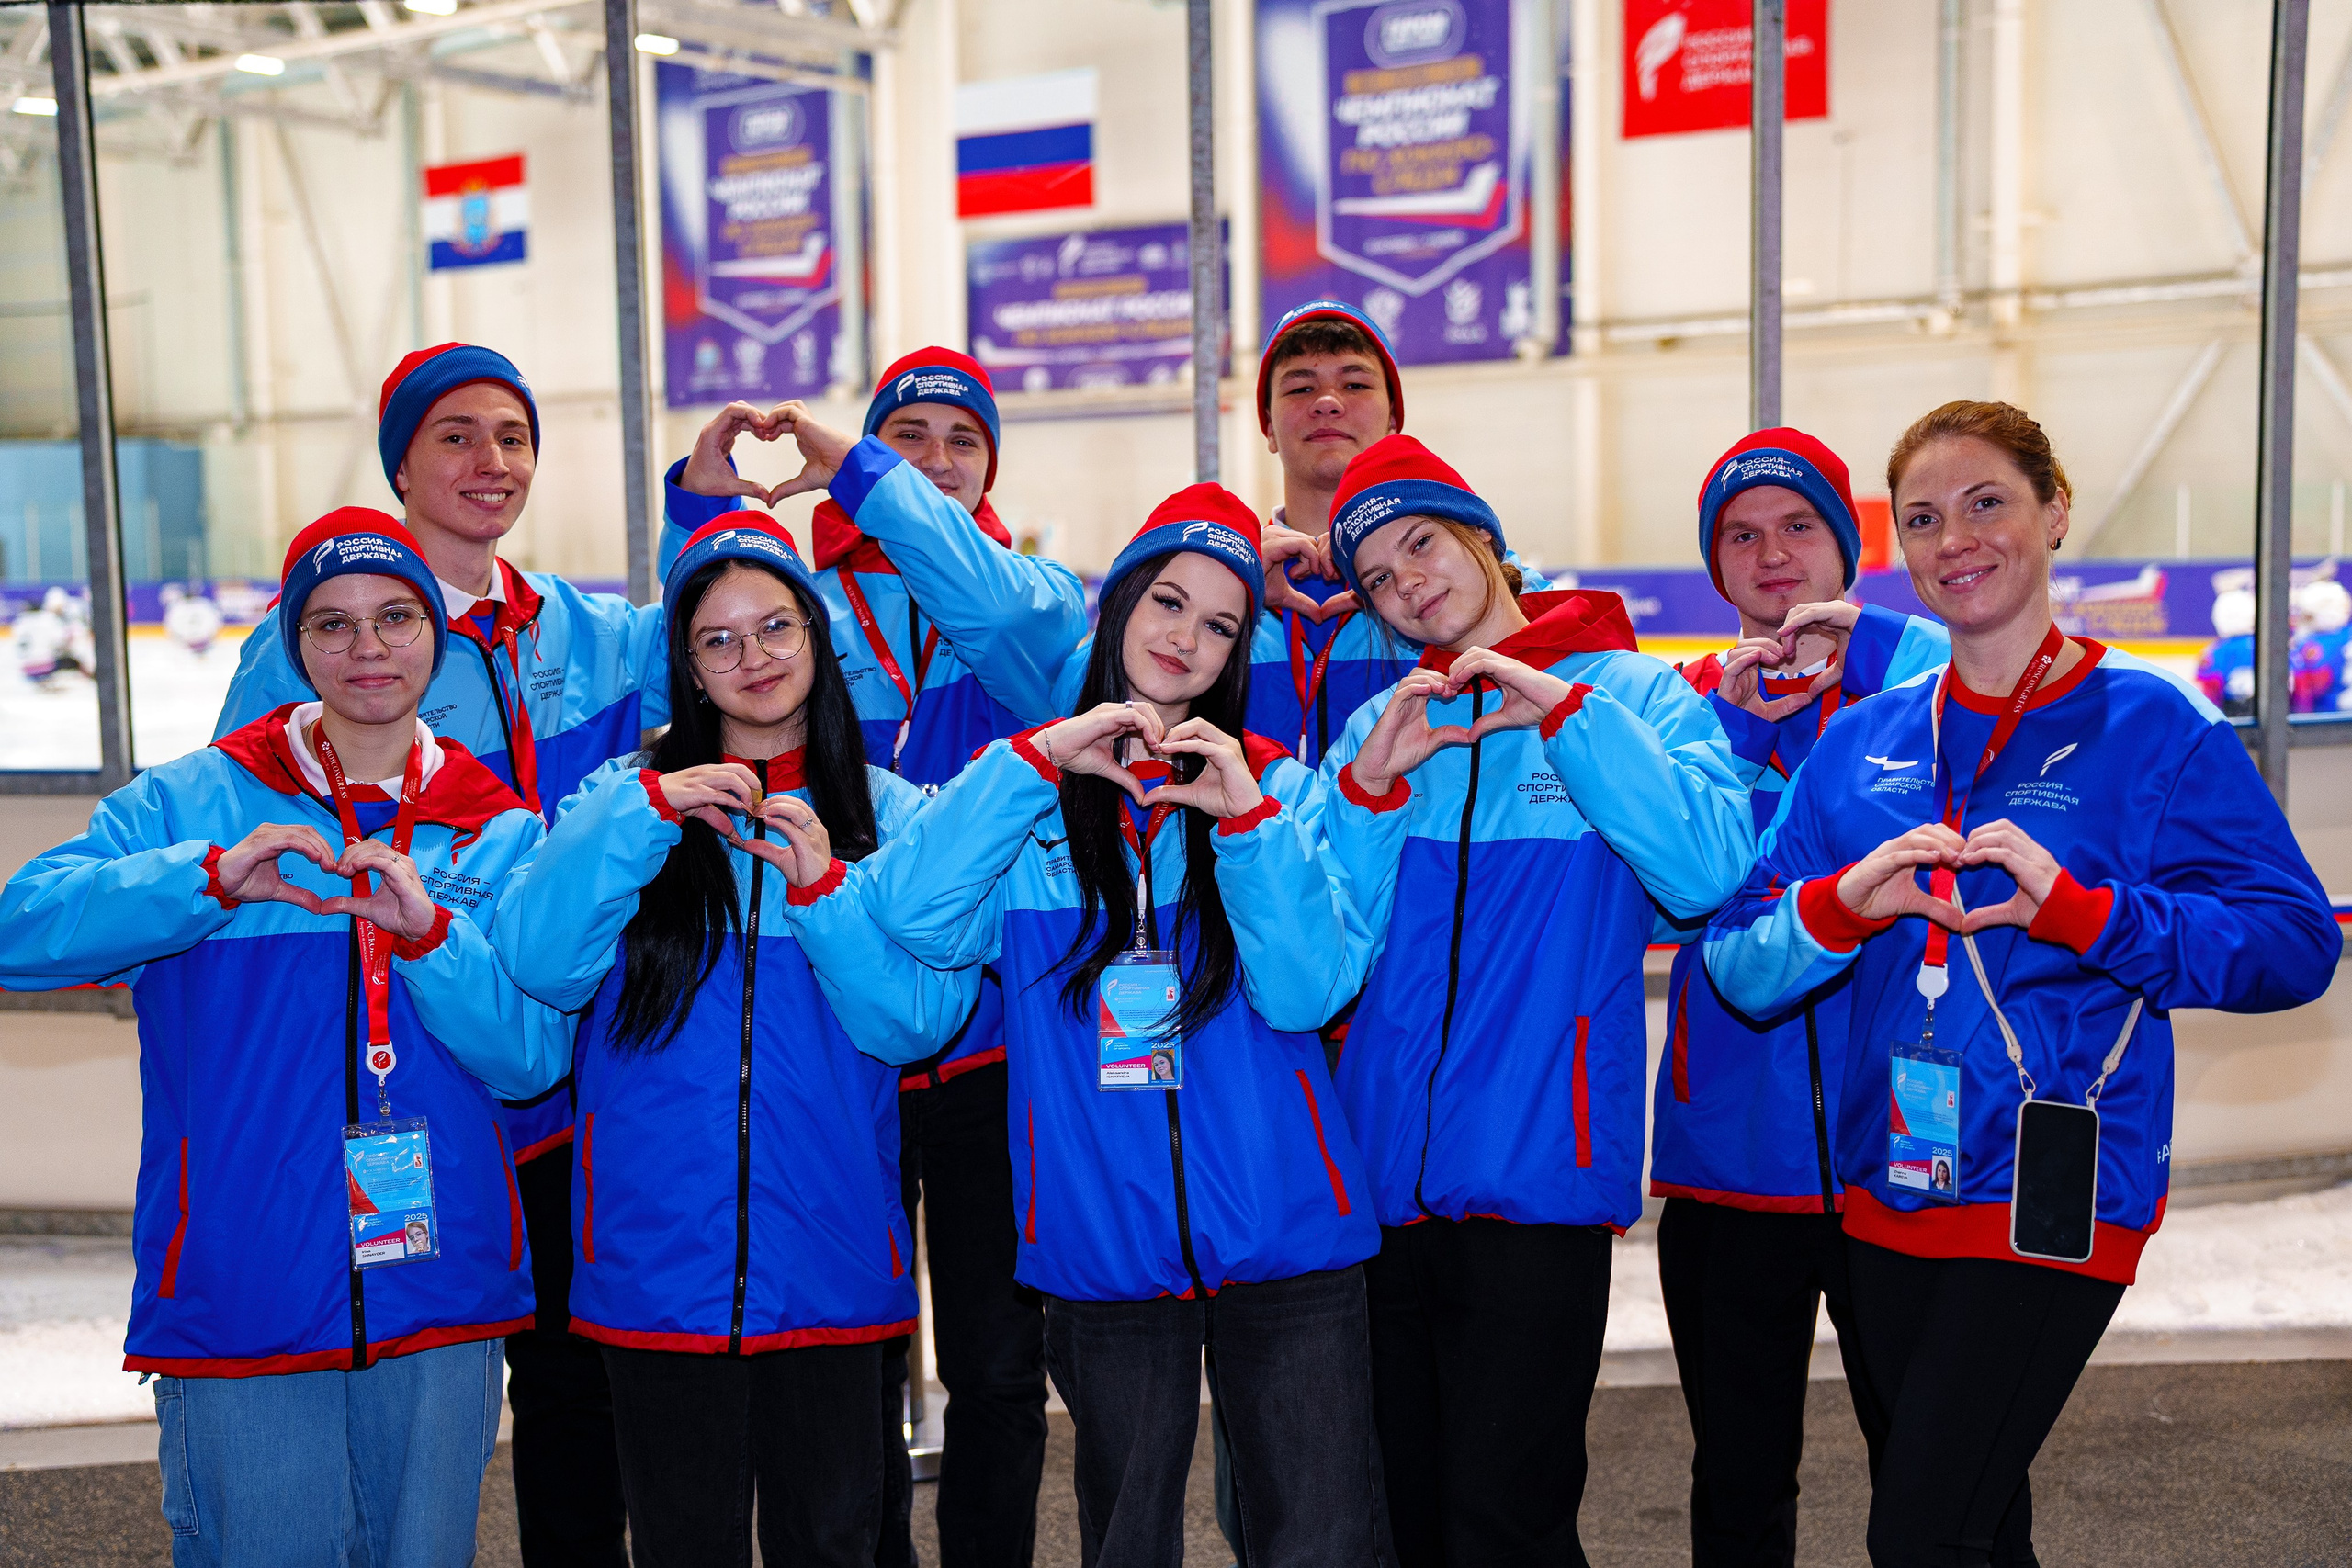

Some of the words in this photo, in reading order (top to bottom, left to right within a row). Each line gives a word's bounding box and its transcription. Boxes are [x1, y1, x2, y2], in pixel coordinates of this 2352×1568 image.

[915, 381, 968, 393] СПОРТИВНАЯ
[917, 388, 961, 397] ДЕРЖАВА
[1741, 463, 1803, 478] СПОРТИВНАЯ
[1741, 469, 1792, 481] ДЕРЖАВА
[1346, 497, 1401, 535] СПОРТИВНАЯ
[1350, 508, 1394, 542] ДЕРЖАВА
[339, 544, 403, 558] СПОРТИВНАЯ
[739, 542, 786, 560] ДЕРЖАВА
[1206, 533, 1255, 565] СПОРТИВНАЯ
[1206, 539, 1250, 565] ДЕРЖАВА
[341, 552, 395, 564] ДЕРЖАВА
[533, 668, 561, 679] РОССИЯ
[2013, 663, 2047, 714] ROSCONGRESS
[325, 749, 348, 799] ROSCONGRESS
[1874, 782, 1922, 791] САМАРСКОЙ
[1877, 777, 1935, 787] ПРАВИТЕЛЬСТВ
[2018, 781, 2064, 791] РОССИЯ
[2005, 790, 2079, 806] СПОРТИВНАЯ
[2008, 797, 2067, 812] ДЕРЖАВА
[1046, 862, 1072, 872] САМАРС
[433, 866, 481, 886] РОССИЯ
[419, 874, 494, 901] СПОРТИВНАЯ
[427, 890, 479, 908] ДЕРЖАВ
[1932, 1146, 1953, 1156] 2025
[1893, 1162, 1927, 1173] VOLUNTEER
[404, 1213, 428, 1222] 2025
[360, 1237, 401, 1247] VOLUNTEER
